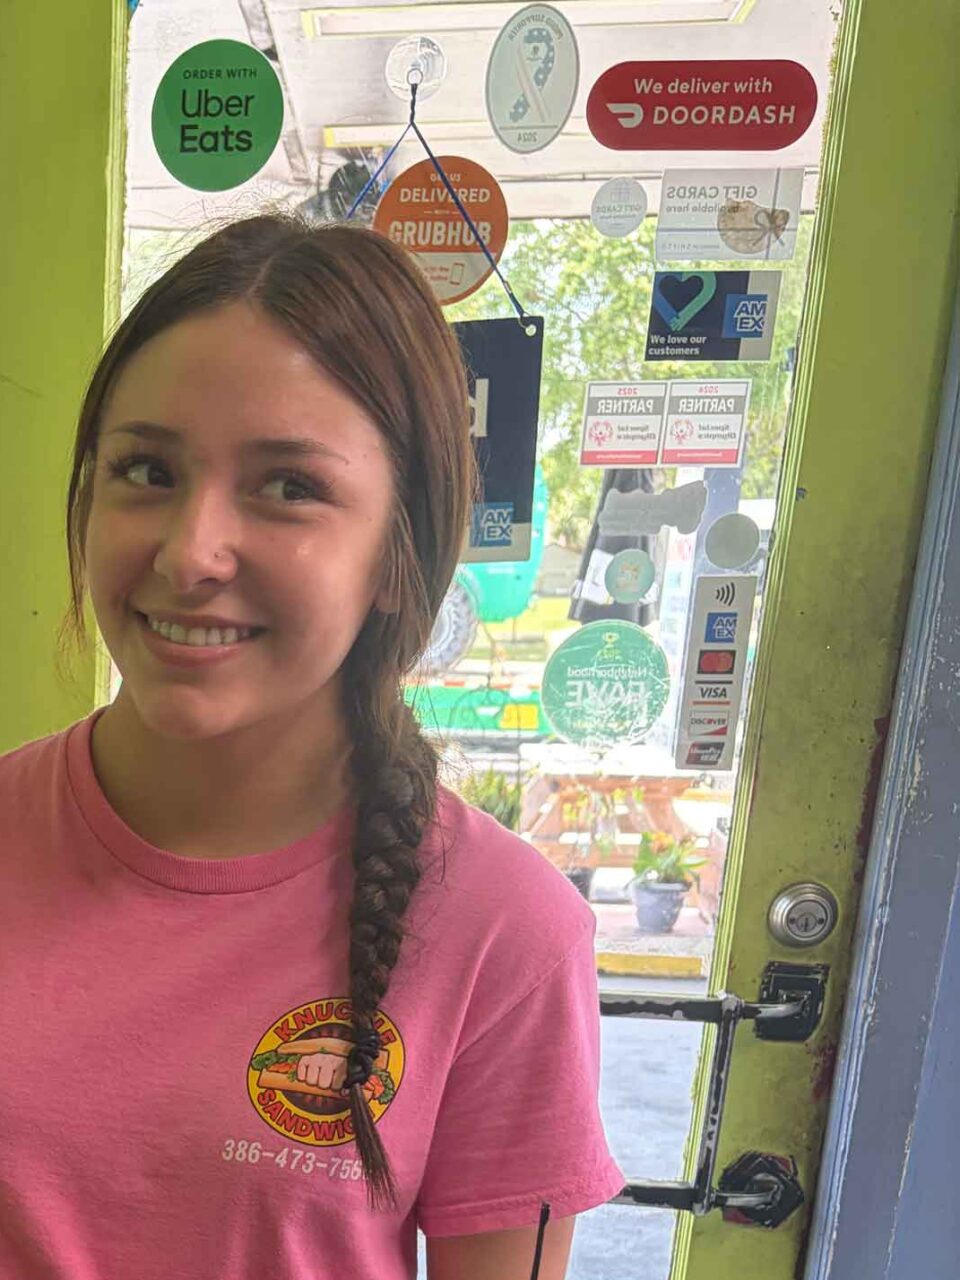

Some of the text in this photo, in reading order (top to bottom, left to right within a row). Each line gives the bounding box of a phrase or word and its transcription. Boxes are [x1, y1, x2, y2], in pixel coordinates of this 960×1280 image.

[183, 67, 258, 80] ORDER WITH
[634, 77, 773, 94] We deliver with
[181, 88, 255, 118] Uber
[652, 104, 797, 126] DOORDASH
[179, 124, 253, 153] Eats
[388, 219, 492, 247] GRUBHUB
[735, 301, 767, 316] AM
[737, 317, 765, 331] EX
[650, 335, 708, 345] We love our
[648, 346, 701, 356] customers
[483, 508, 513, 524] AM
[486, 524, 512, 540] EX
[714, 617, 737, 627] AM
[716, 627, 736, 638] EX
[700, 687, 727, 698] VISA
[272, 1001, 397, 1047] KNUCLE
[256, 1088, 358, 1142] SANDWIC
[221, 1139, 367, 1180] 386-473-756
